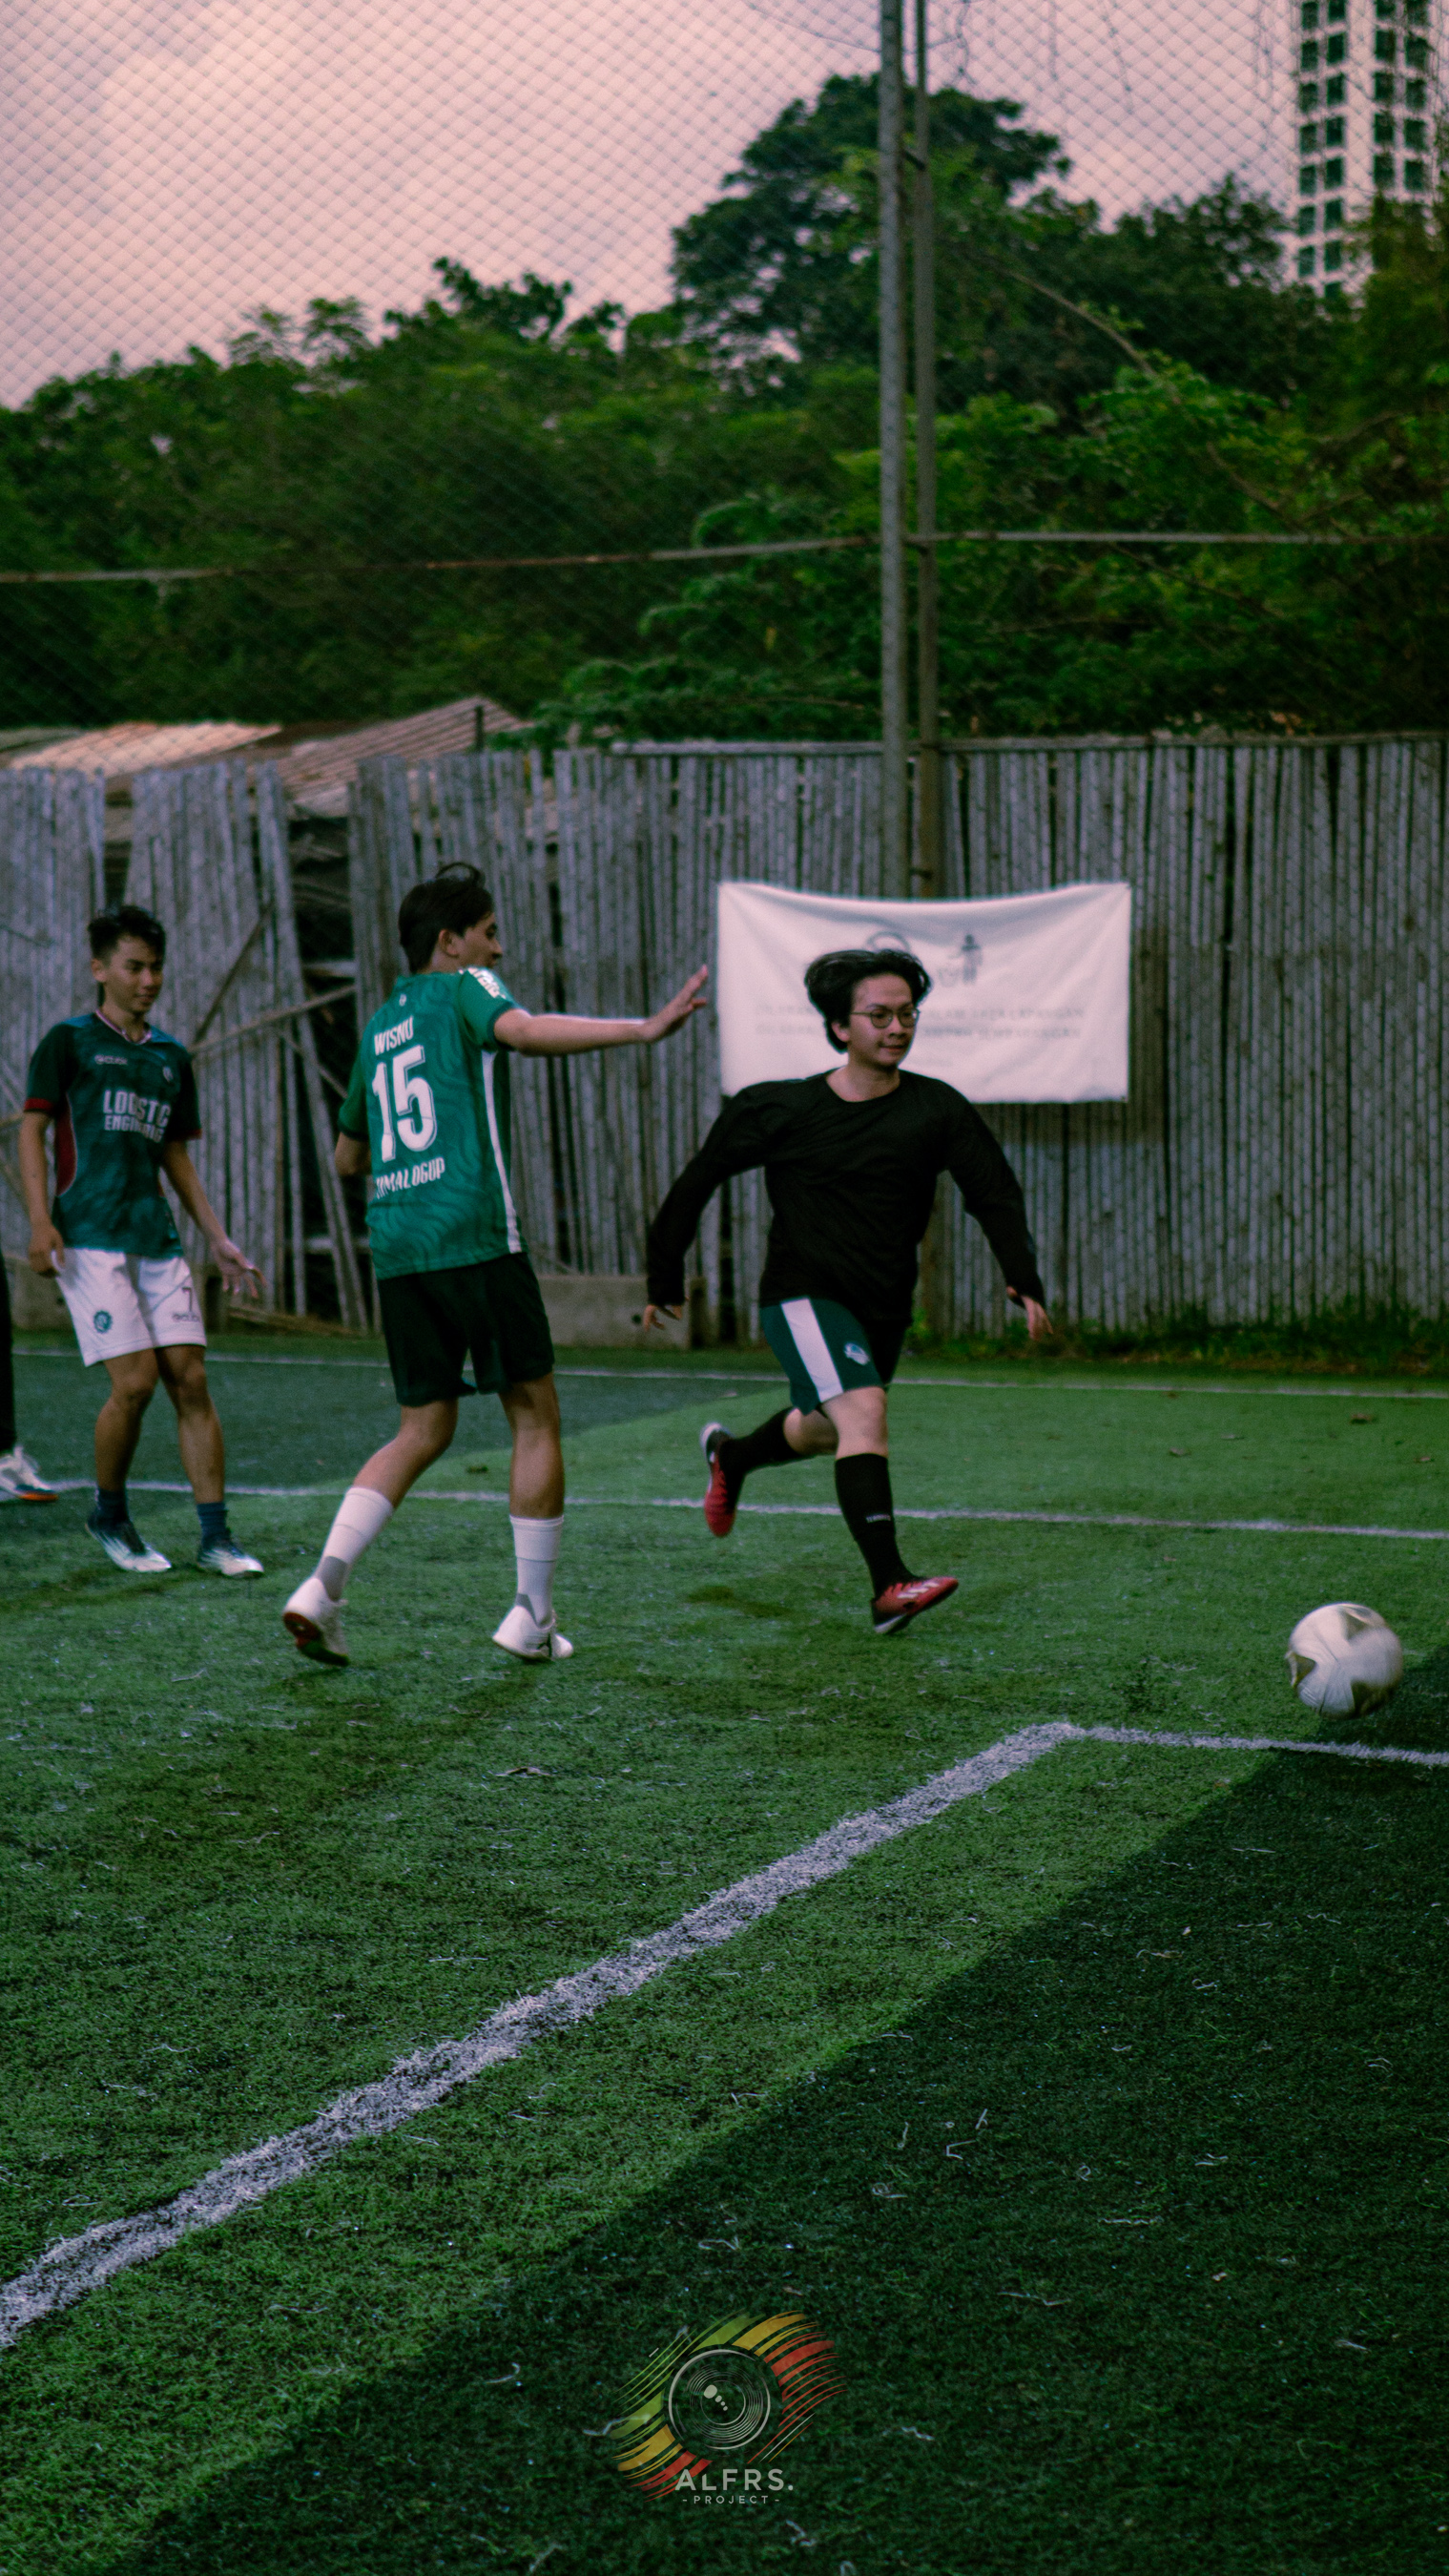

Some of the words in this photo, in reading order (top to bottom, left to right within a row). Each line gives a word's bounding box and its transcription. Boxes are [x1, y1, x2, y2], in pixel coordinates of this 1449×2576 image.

[373, 1015, 414, 1056] WISNU
[371, 1044, 438, 1164] 15
[181, 1286, 194, 1313] 7
